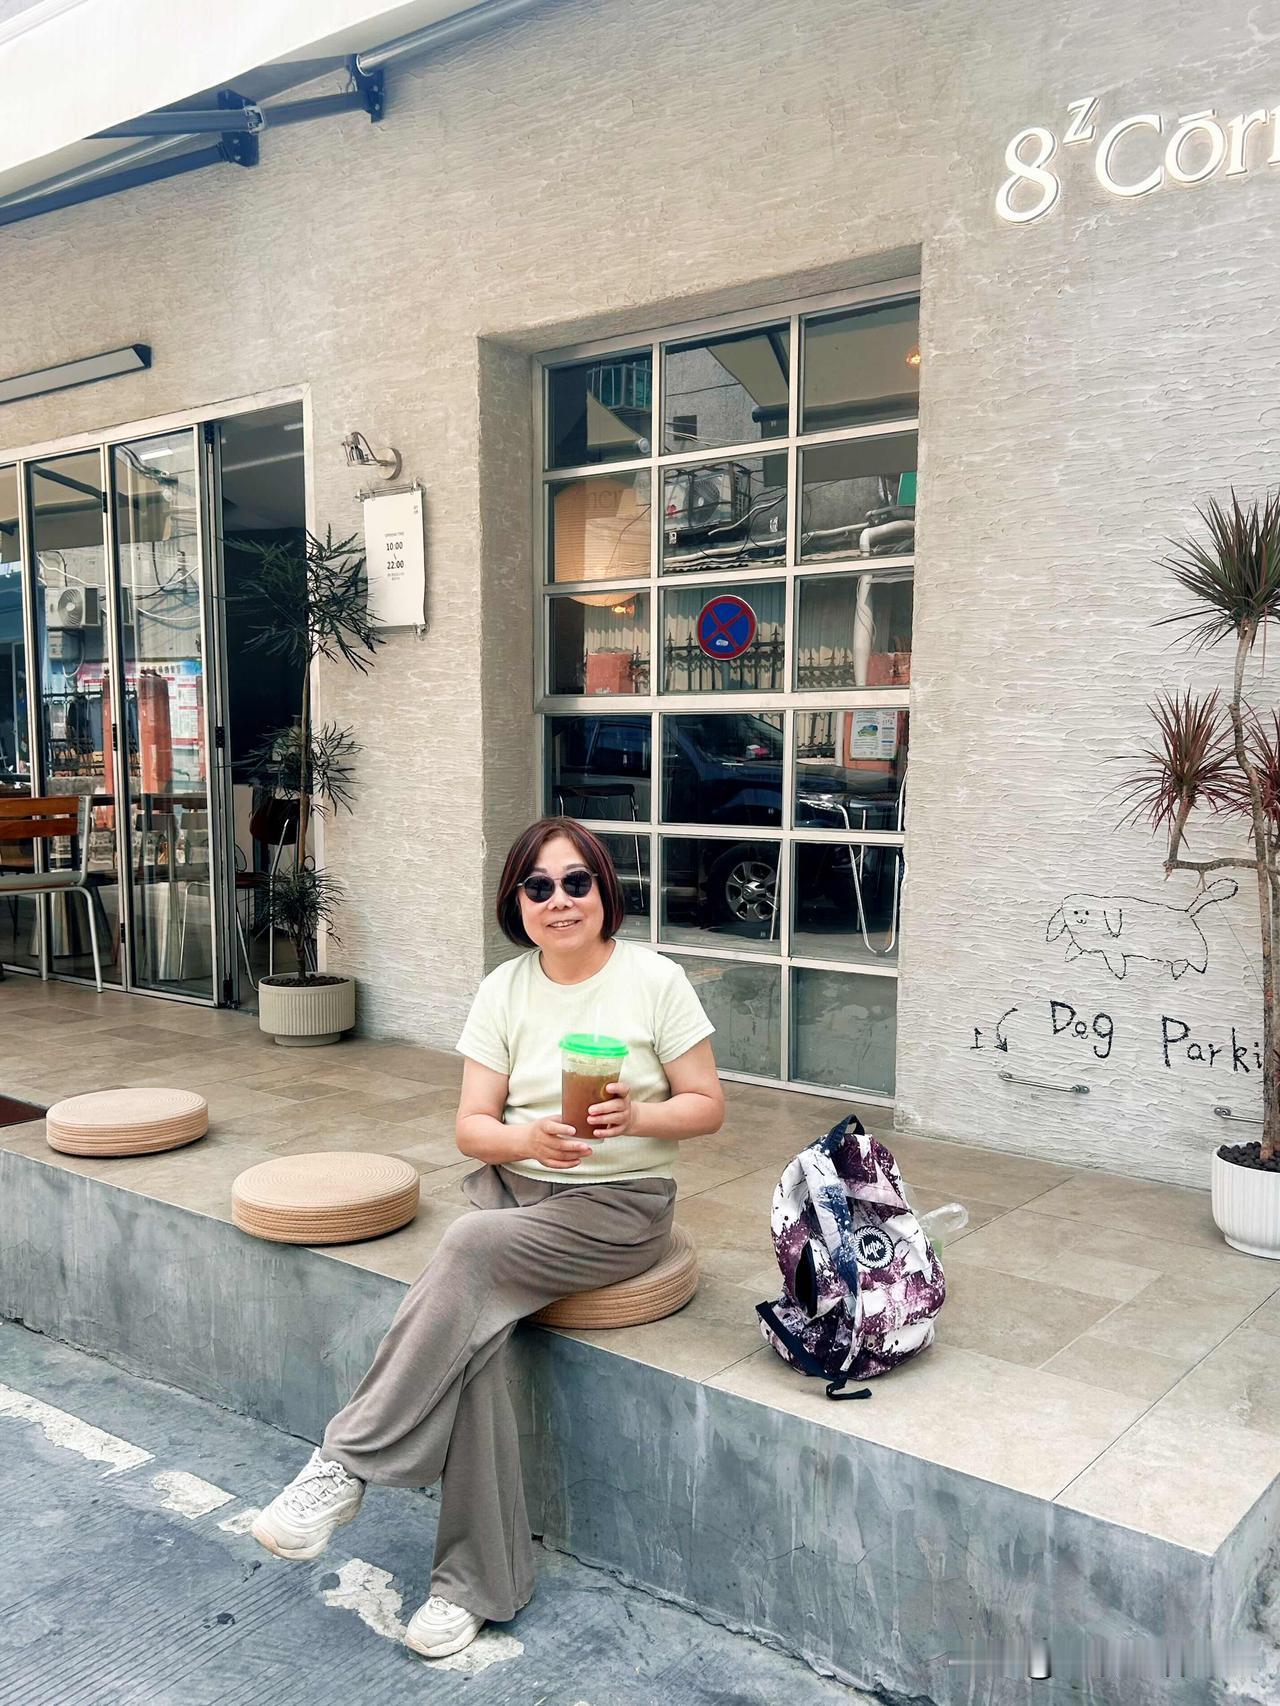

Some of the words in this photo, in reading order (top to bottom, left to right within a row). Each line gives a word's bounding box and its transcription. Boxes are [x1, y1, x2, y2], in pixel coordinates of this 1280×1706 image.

[386, 541, 404, 551] 10:00
[386, 559, 405, 570] 22:00
[1050, 1000, 1114, 1059] Dog
[1162, 1015, 1263, 1073] Parki
